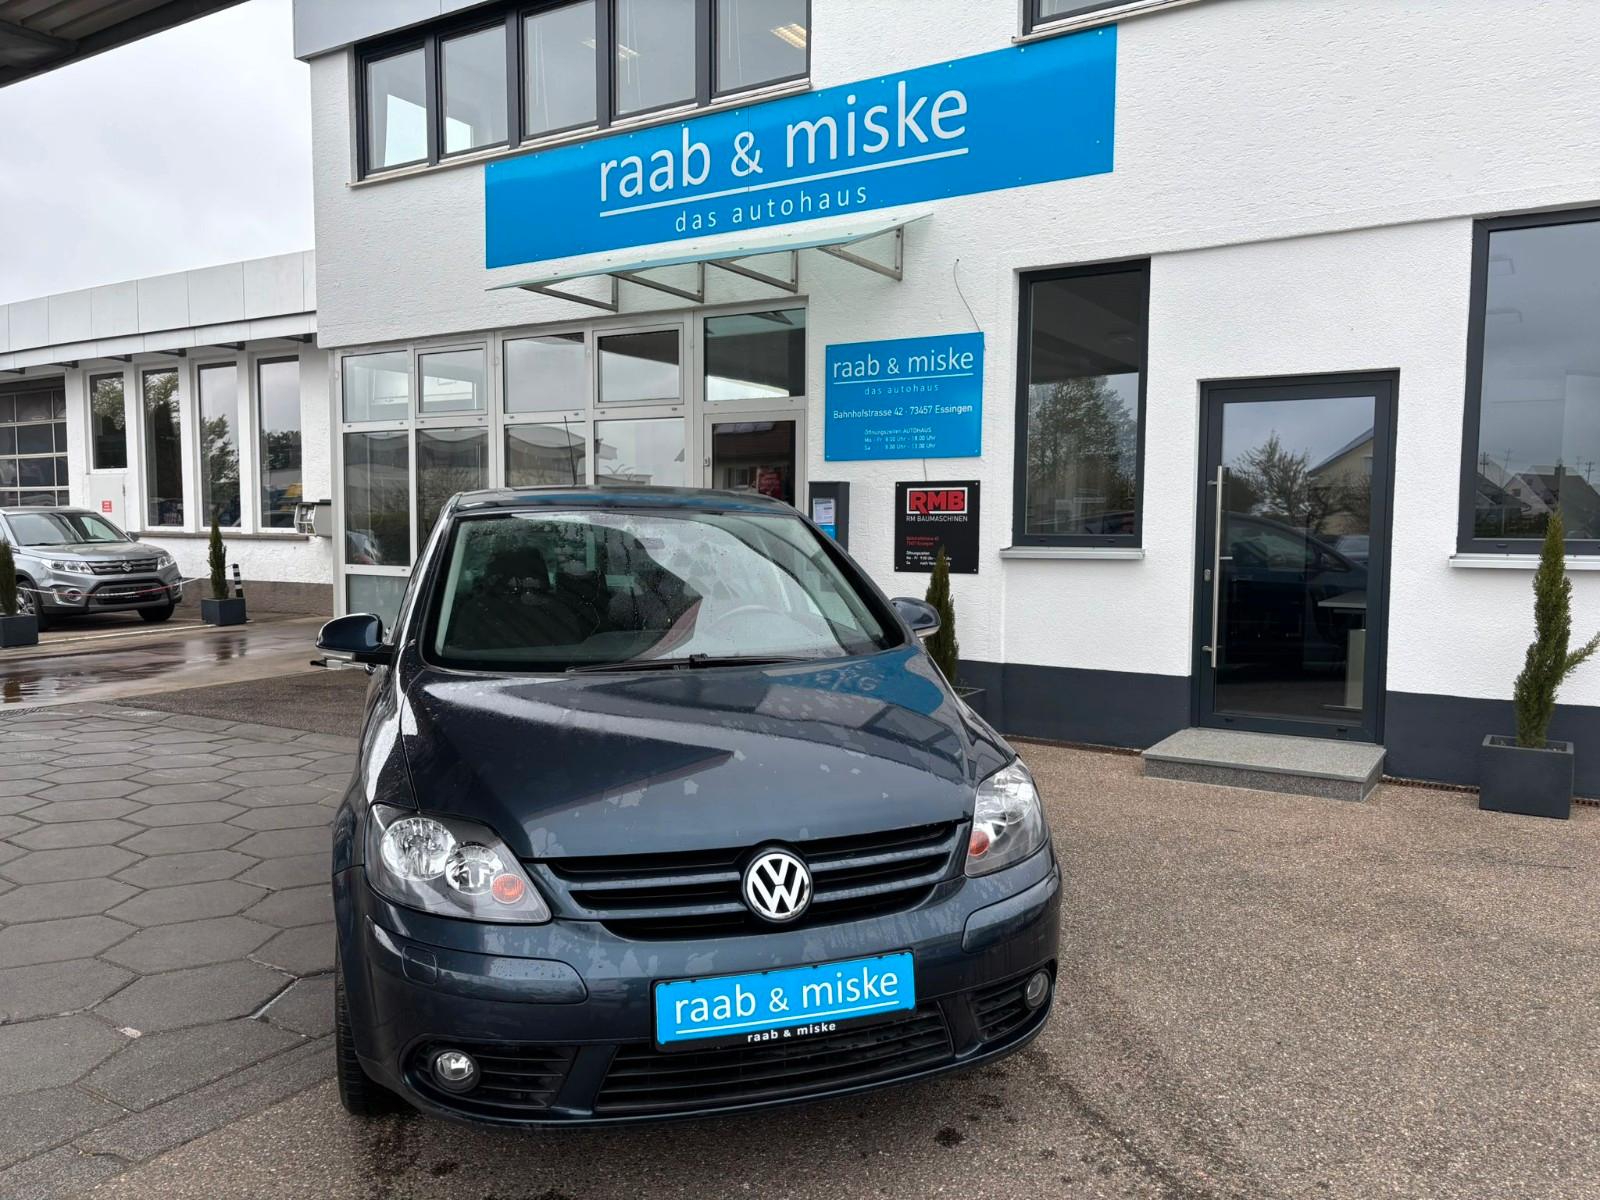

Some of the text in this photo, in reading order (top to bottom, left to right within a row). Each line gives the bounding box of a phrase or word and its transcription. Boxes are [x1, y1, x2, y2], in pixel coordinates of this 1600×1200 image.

[600, 80, 968, 202] raab & miske
[675, 186, 867, 232] das autohaus
[833, 347, 974, 378] raab & miske
[864, 383, 939, 396] das autohaus
[833, 409, 892, 419] Bahnhofstrasse
[893, 407, 904, 416] 42
[909, 404, 933, 415] 73457
[935, 404, 973, 415] Essingen
[910, 490, 964, 515] RMB
[746, 852, 810, 920] VW
[675, 967, 898, 1024] raab & miske
[747, 1022, 836, 1043] raab & miske
